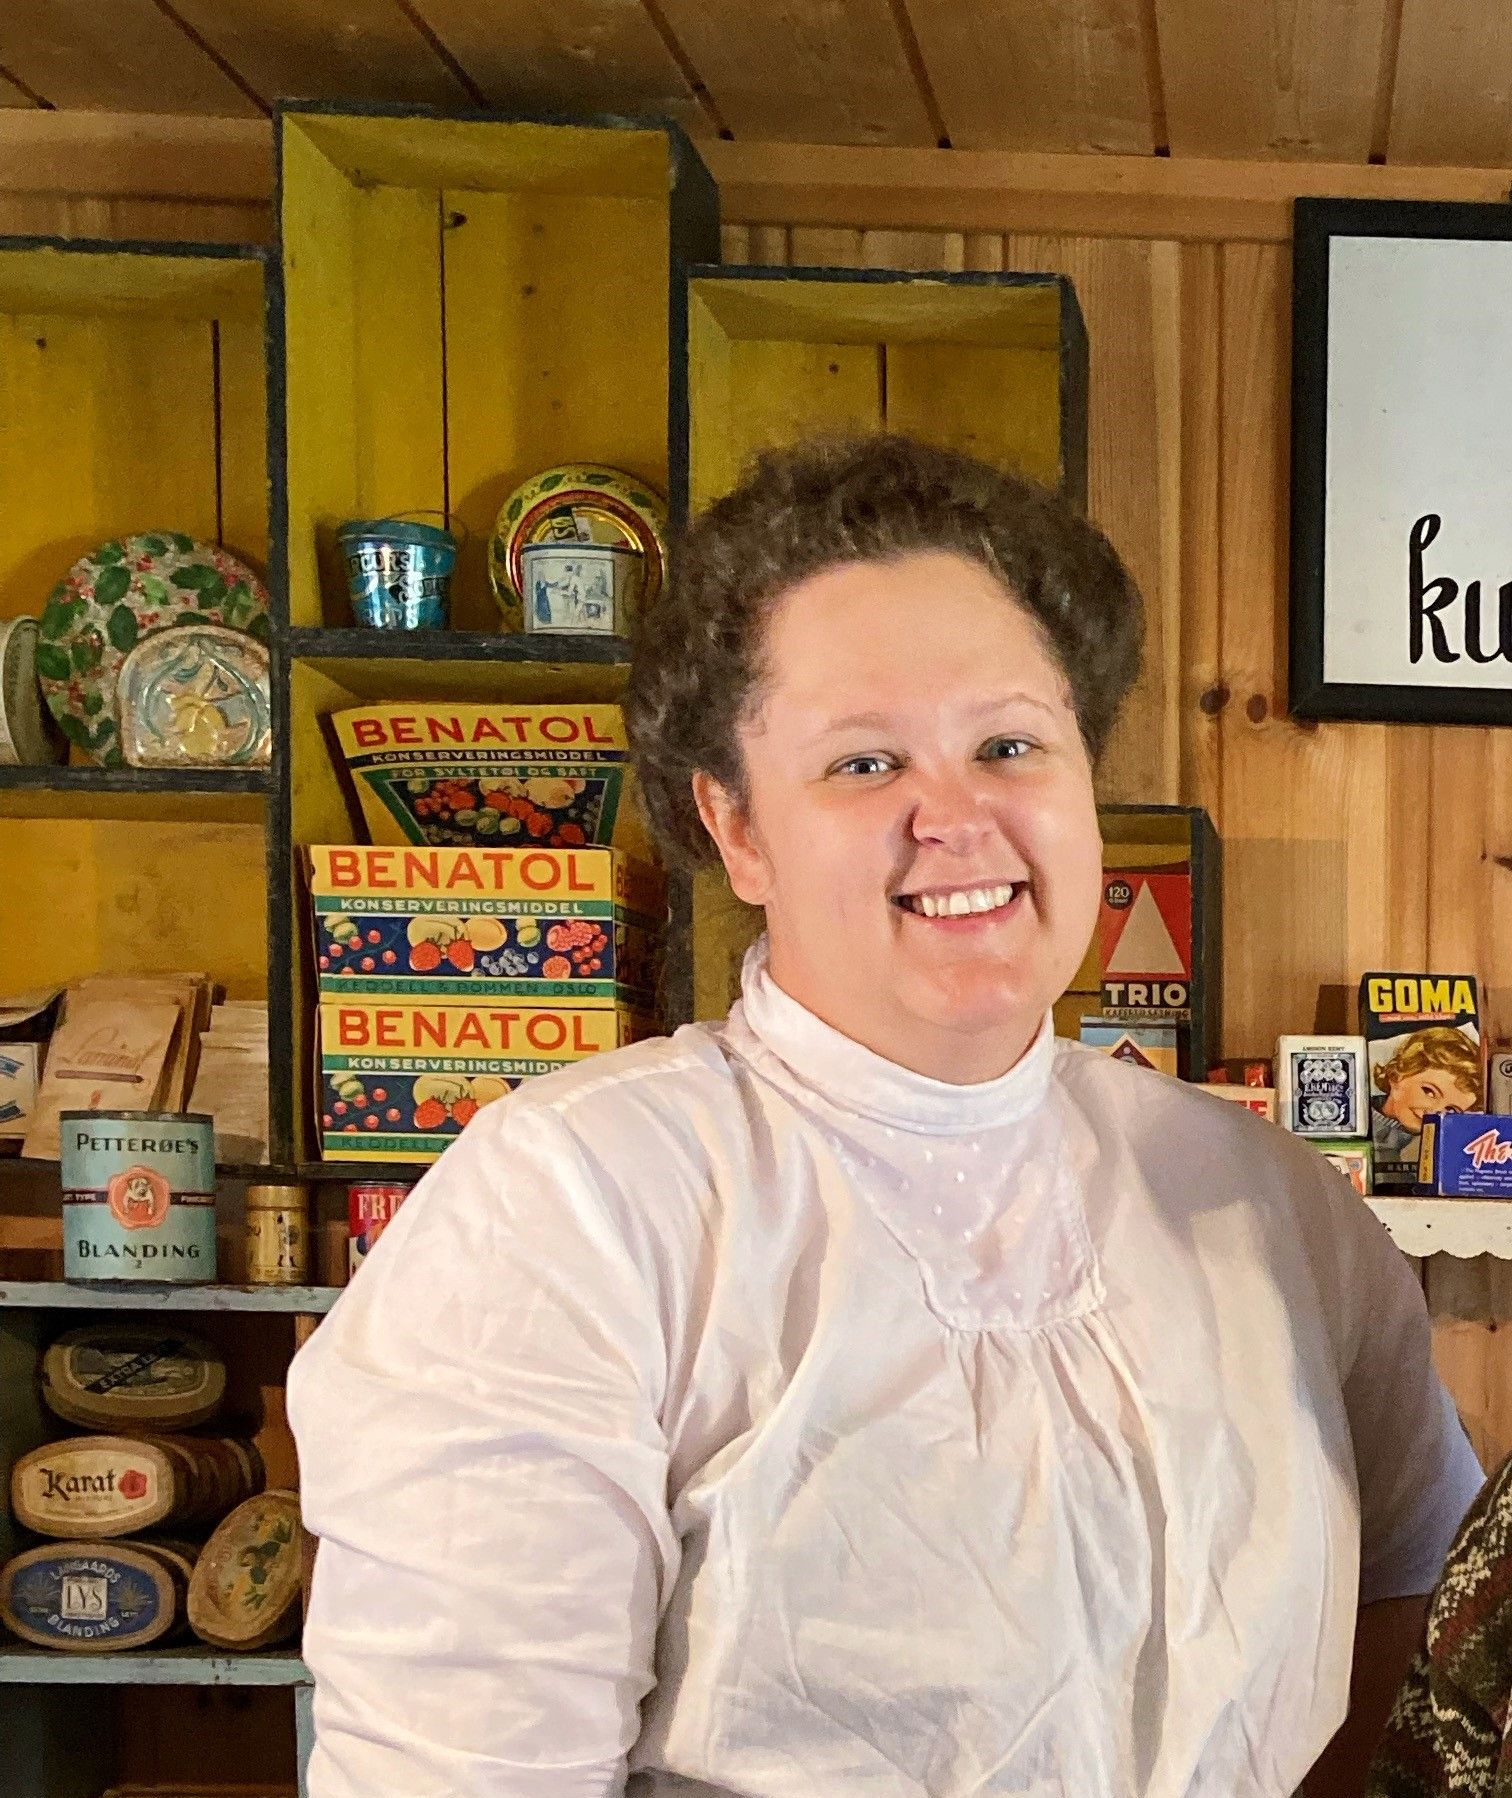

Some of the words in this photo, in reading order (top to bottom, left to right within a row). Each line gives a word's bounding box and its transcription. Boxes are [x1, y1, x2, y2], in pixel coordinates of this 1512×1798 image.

[351, 715, 614, 748] BENATOL
[372, 750, 607, 764] KONSERVERINGSMIDDEL
[328, 850, 596, 892] BENATOL
[1108, 886, 1130, 899] 120
[340, 898, 584, 915] KONSERVERINGSMIDDEL
[552, 984, 598, 995] OSLO
[1105, 983, 1187, 1007] TRIO
[1367, 978, 1477, 1015] GOMA
[339, 1009, 600, 1053] BENATOL
[347, 1057, 571, 1075] KONSERVERINGSMIDD
[76, 1132, 200, 1155] PETTERØE'S
[1463, 1127, 1511, 1169] The
[78, 1239, 200, 1259] BLANDING
[135, 1259, 143, 1269] 2
[39, 1467, 116, 1501] Karat
